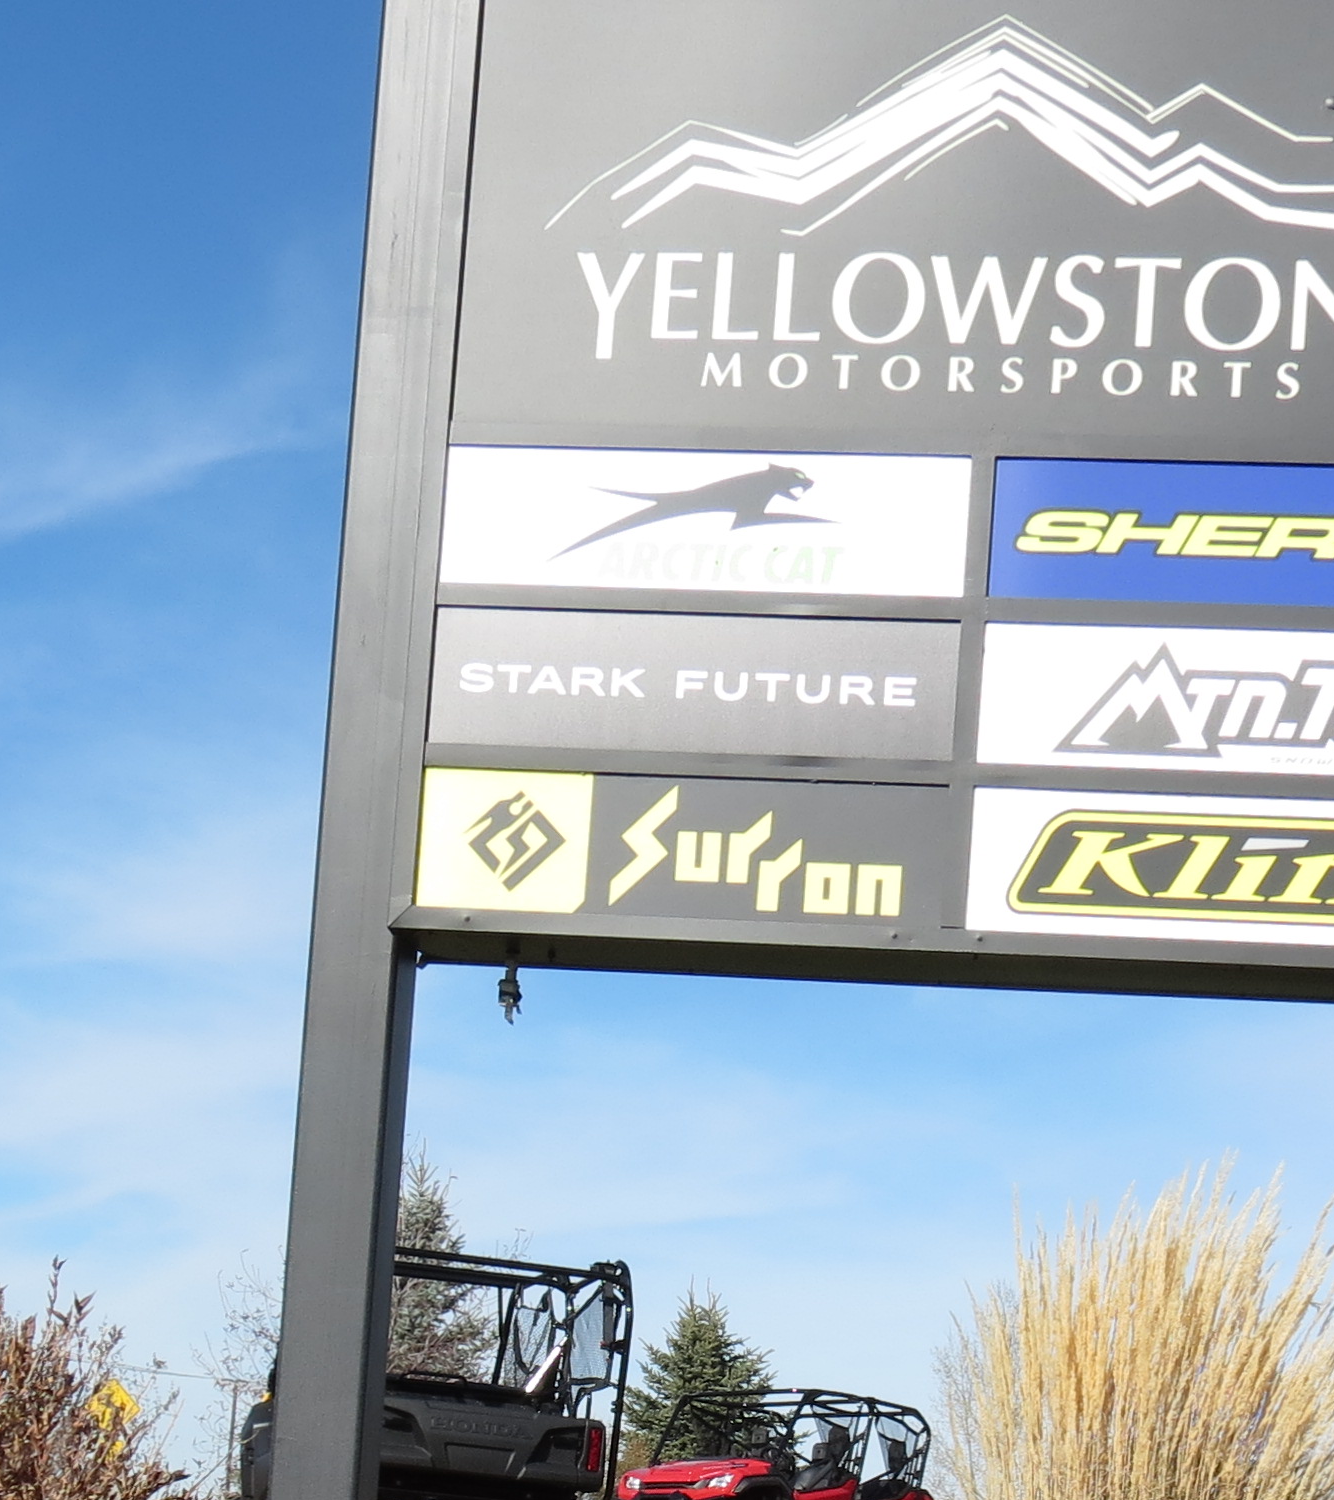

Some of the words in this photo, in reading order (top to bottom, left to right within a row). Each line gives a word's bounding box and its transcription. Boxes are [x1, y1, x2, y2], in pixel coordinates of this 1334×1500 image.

[700, 352, 1302, 400] MOTORSPORTS
[598, 541, 753, 582] ARCTIC
[763, 545, 844, 584] CAT
[459, 664, 646, 697] STARK
[675, 671, 917, 706] FUTURE
[608, 784, 903, 918] Surron
